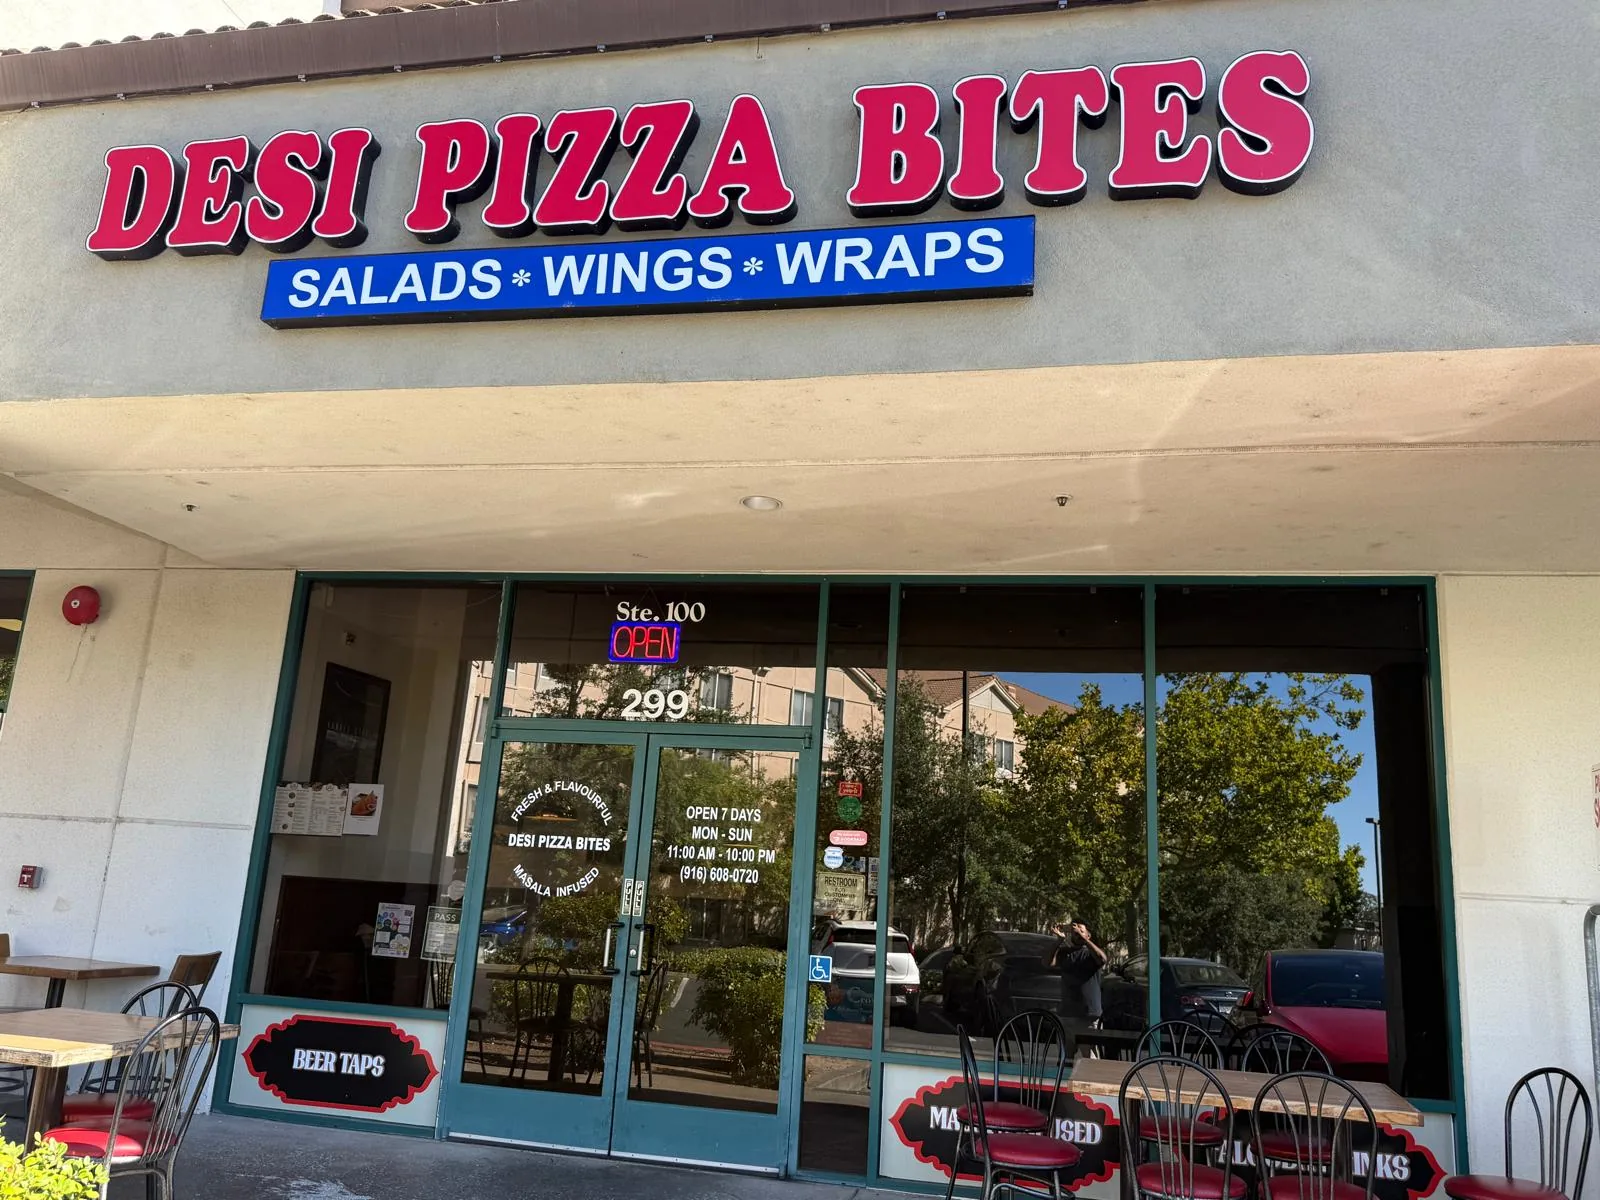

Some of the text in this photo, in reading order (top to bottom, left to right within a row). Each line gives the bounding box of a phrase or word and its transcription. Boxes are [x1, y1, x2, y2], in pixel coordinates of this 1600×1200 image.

[85, 49, 1315, 254] DESI PIZZA BITES
[288, 226, 1005, 309] SALADS WINGS WRAPS
[616, 601, 706, 623] Ste. 100
[613, 626, 677, 660] OPEN
[620, 688, 689, 719] 299
[511, 781, 613, 826] FRESH & FLAVOURFUL
[686, 806, 761, 822] OPEN 7 DAYS
[508, 833, 611, 852] DESI PIZZA BITES
[691, 826, 718, 840] MON
[728, 827, 753, 842] SUN
[667, 844, 695, 859] 11:00
[697, 846, 716, 860] AM
[726, 847, 755, 862] 10:00
[757, 849, 776, 864] PM
[513, 864, 599, 897] MASALA INFUSED
[680, 865, 759, 884] (916) 608-0720
[824, 876, 858, 888] RESTROOM
[624, 882, 632, 906] PULL
[635, 883, 643, 908] PULL
[434, 912, 457, 922] PASS
[292, 1048, 386, 1078] BEER TAPS
